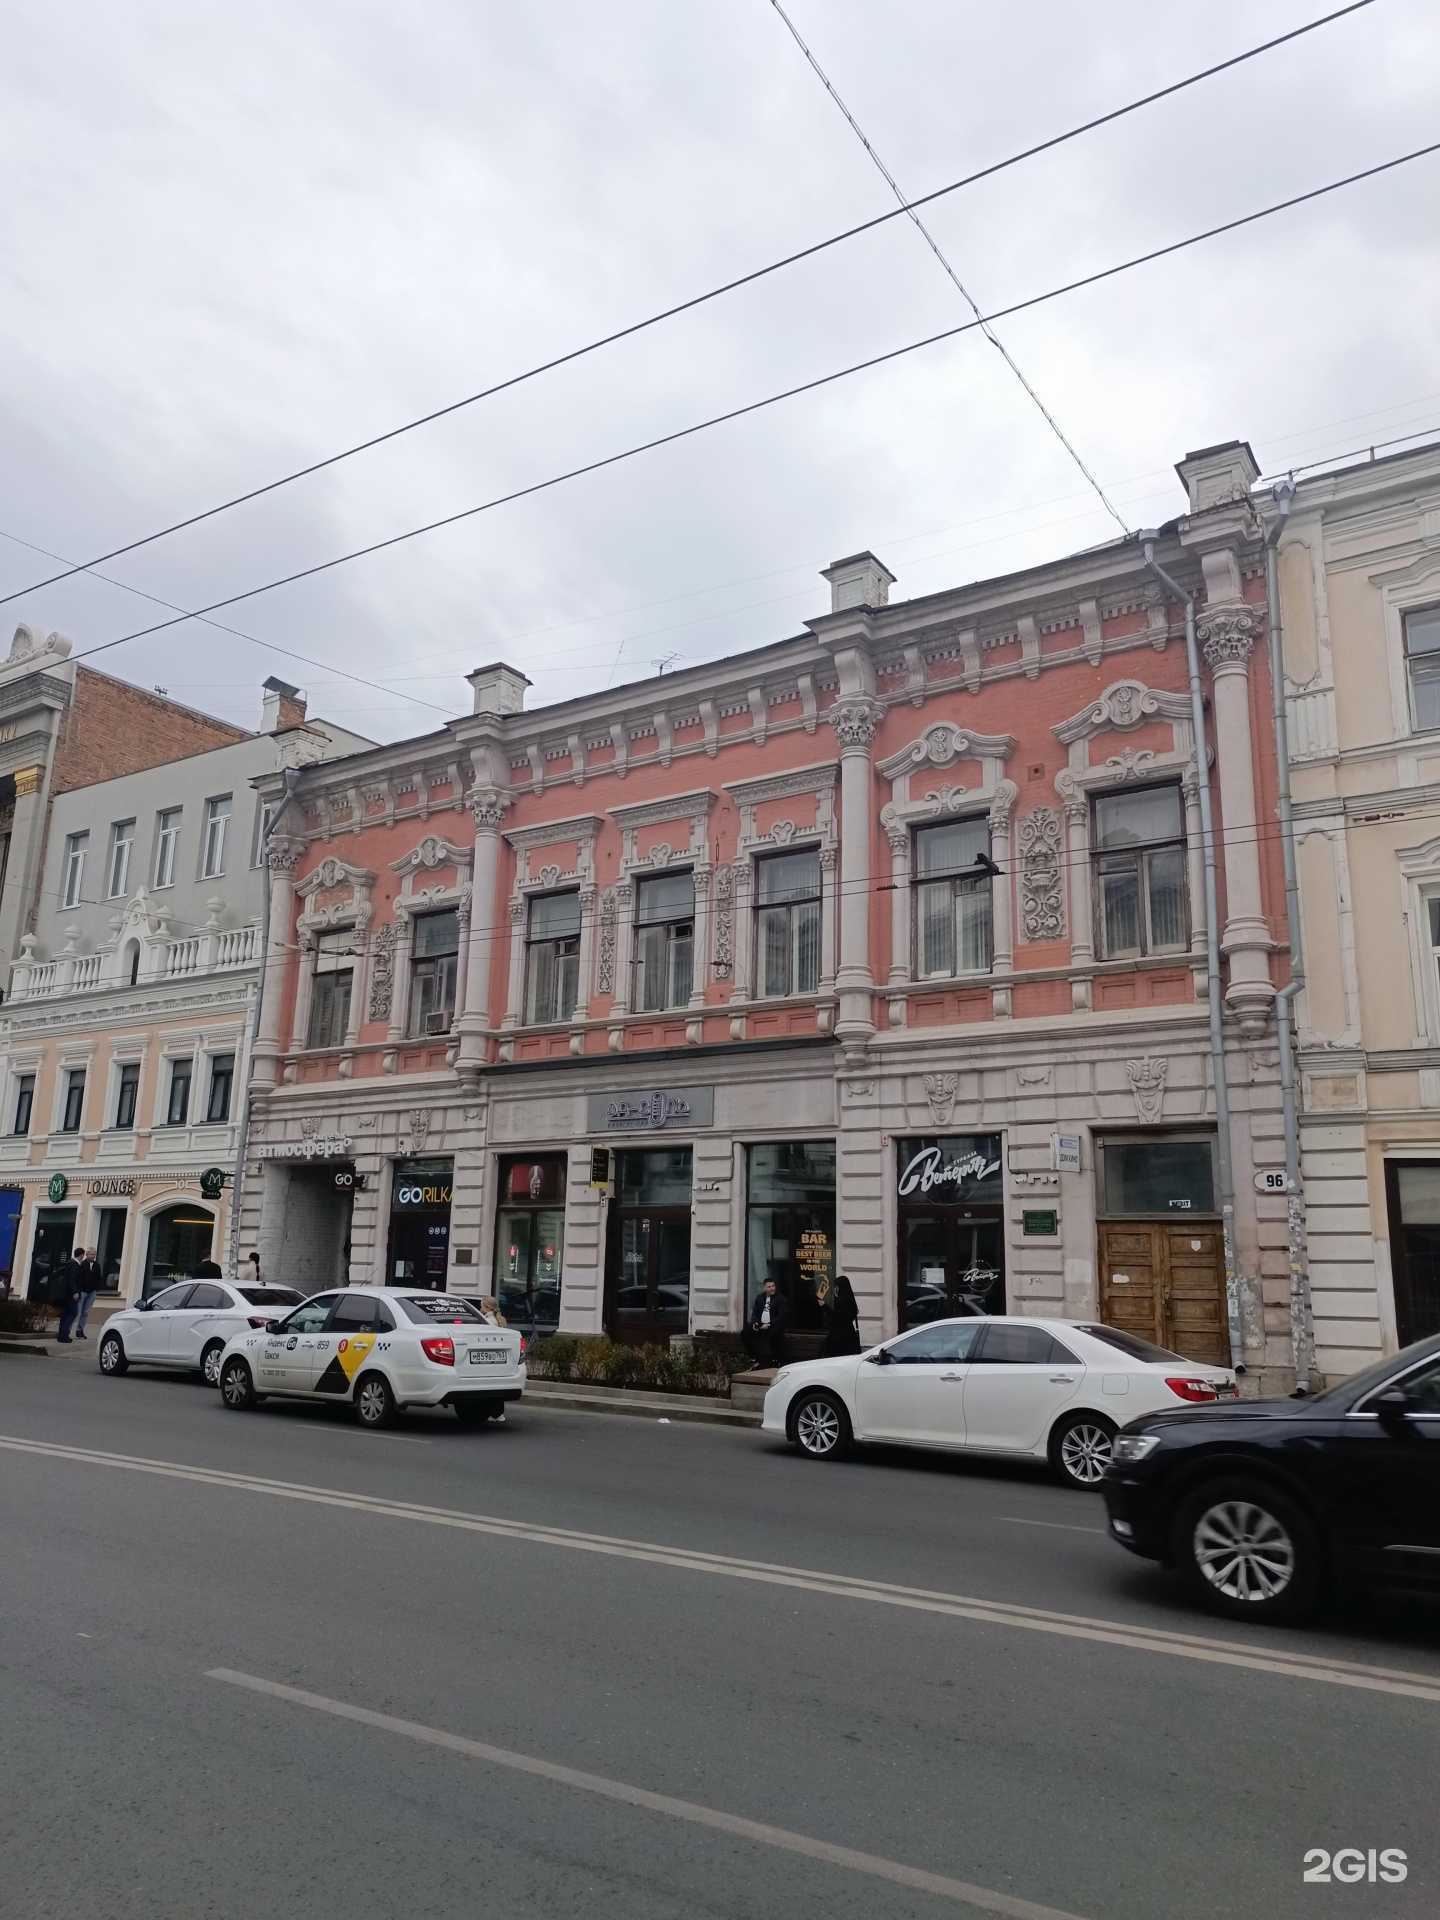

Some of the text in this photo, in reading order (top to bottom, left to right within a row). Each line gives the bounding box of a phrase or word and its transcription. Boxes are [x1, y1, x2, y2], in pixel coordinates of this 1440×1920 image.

[335, 1173, 353, 1186] GO
[1266, 1174, 1284, 1188] 96
[86, 1179, 135, 1196] LOUNGE
[801, 1233, 828, 1245] BAR
[800, 1263, 828, 1271] WORLD
[316, 1340, 330, 1350] 859
